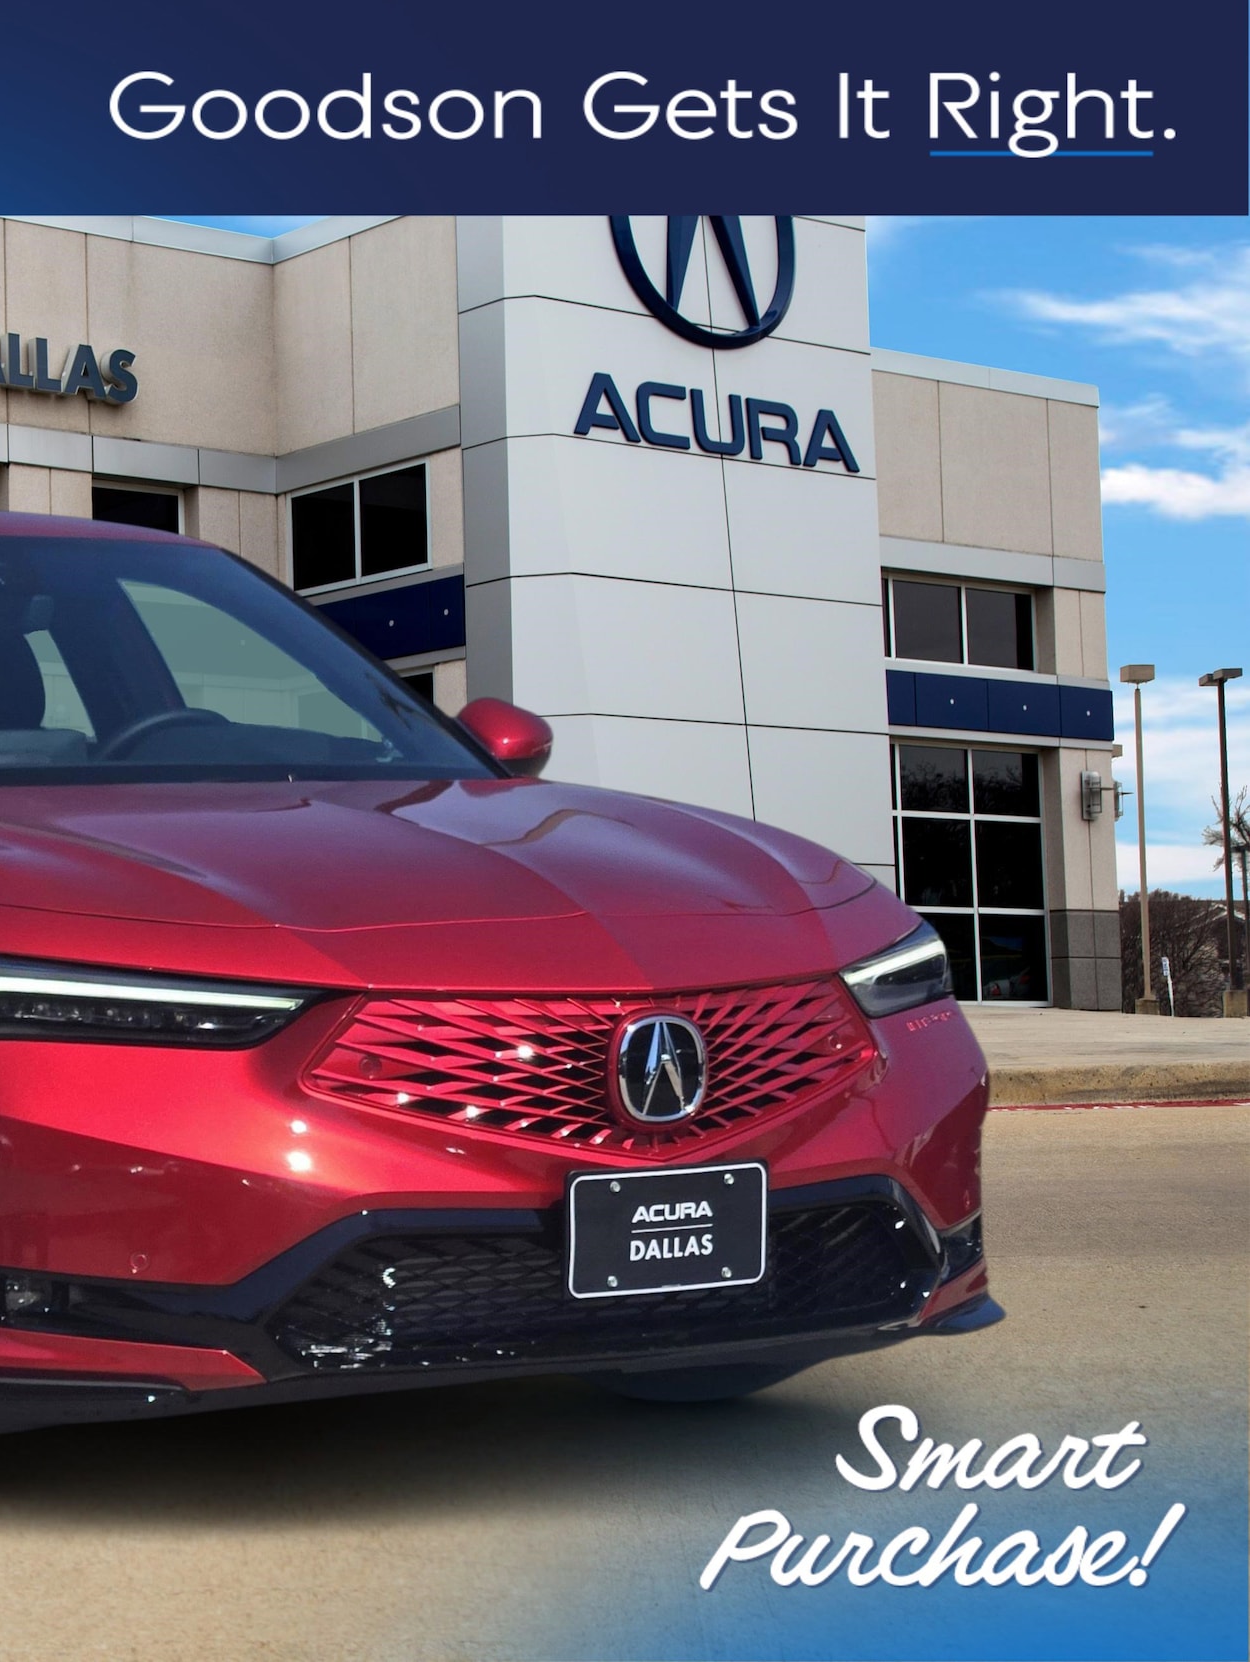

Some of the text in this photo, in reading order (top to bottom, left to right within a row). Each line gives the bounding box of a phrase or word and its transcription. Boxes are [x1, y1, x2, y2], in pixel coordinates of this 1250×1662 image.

[573, 371, 861, 474] ACURA
[631, 1200, 714, 1224] ACURA
[629, 1233, 714, 1262] DALLAS
